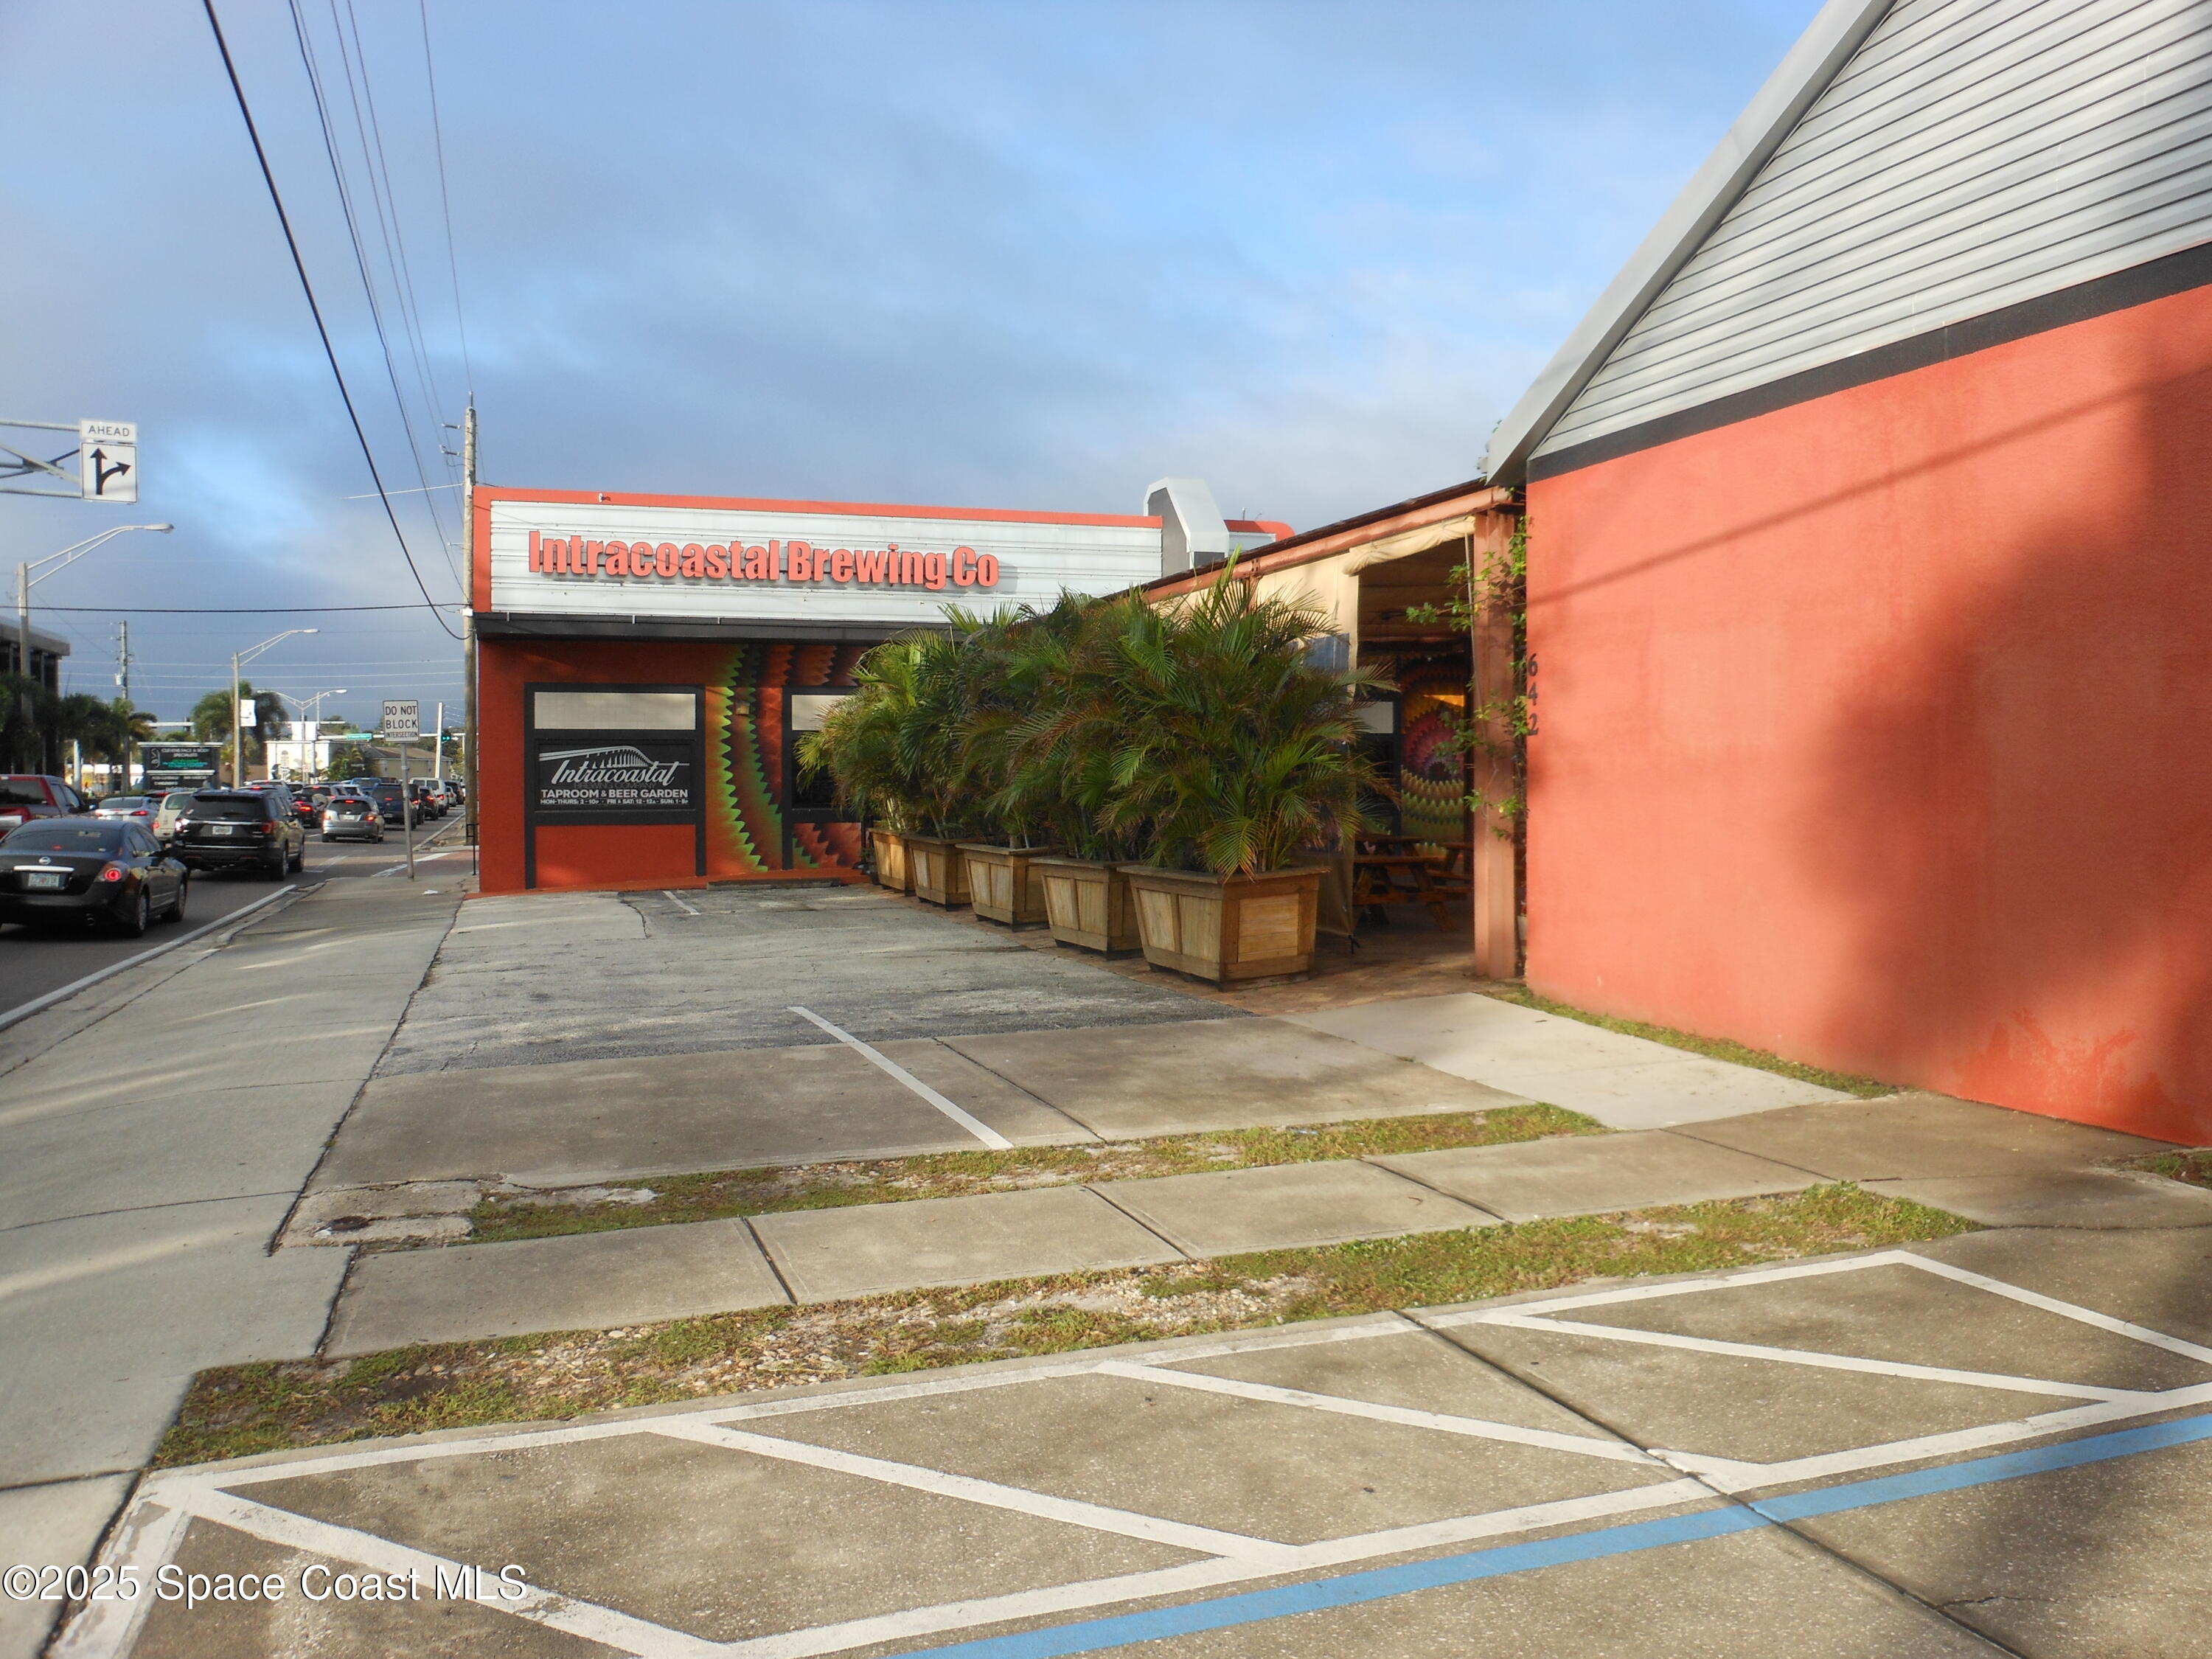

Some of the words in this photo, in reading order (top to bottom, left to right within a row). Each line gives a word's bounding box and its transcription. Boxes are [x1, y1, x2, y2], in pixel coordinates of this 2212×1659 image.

[88, 425, 130, 437] AHEAD
[529, 531, 780, 580] Intracoastal
[787, 540, 947, 590] Brewing
[952, 546, 999, 587] Co
[1528, 653, 1539, 736] 642
[385, 706, 397, 715] DO
[400, 706, 417, 715] NOT
[386, 719, 417, 729] BLOCK
[551, 759, 680, 787] Intracoastal
[540, 789, 599, 798] TAPROOM
[608, 789, 638, 798] BEER
[640, 789, 688, 798] GARDEN
